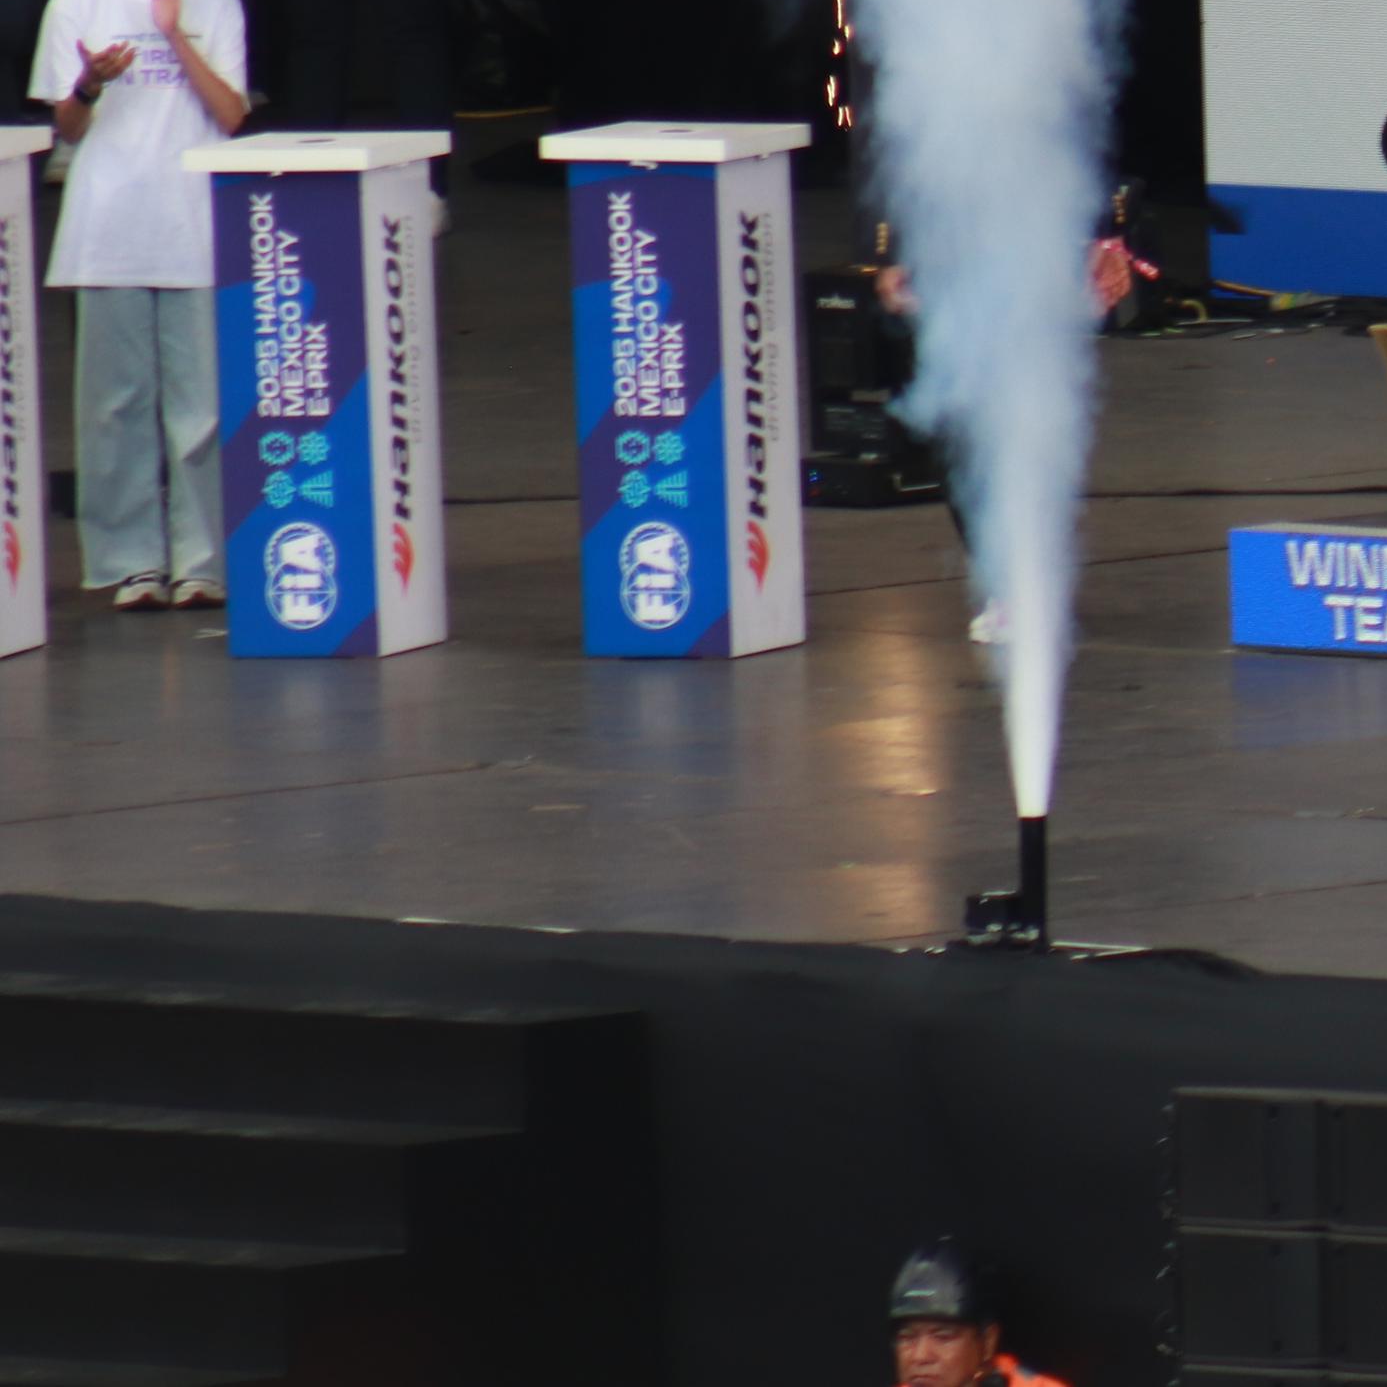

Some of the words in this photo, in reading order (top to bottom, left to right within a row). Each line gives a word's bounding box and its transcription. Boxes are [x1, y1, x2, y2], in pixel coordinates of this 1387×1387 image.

[249, 193, 275, 334] HANKOOK
[277, 230, 300, 296] CITY
[608, 191, 634, 333] HANKOOK
[634, 229, 658, 295] CITY
[255, 340, 282, 418] 2025
[278, 301, 305, 417] MEXICO
[304, 322, 331, 417] E-PRIX
[613, 340, 639, 418] 2025
[635, 300, 662, 417] MEXICO
[660, 322, 687, 417] E-PRIX
